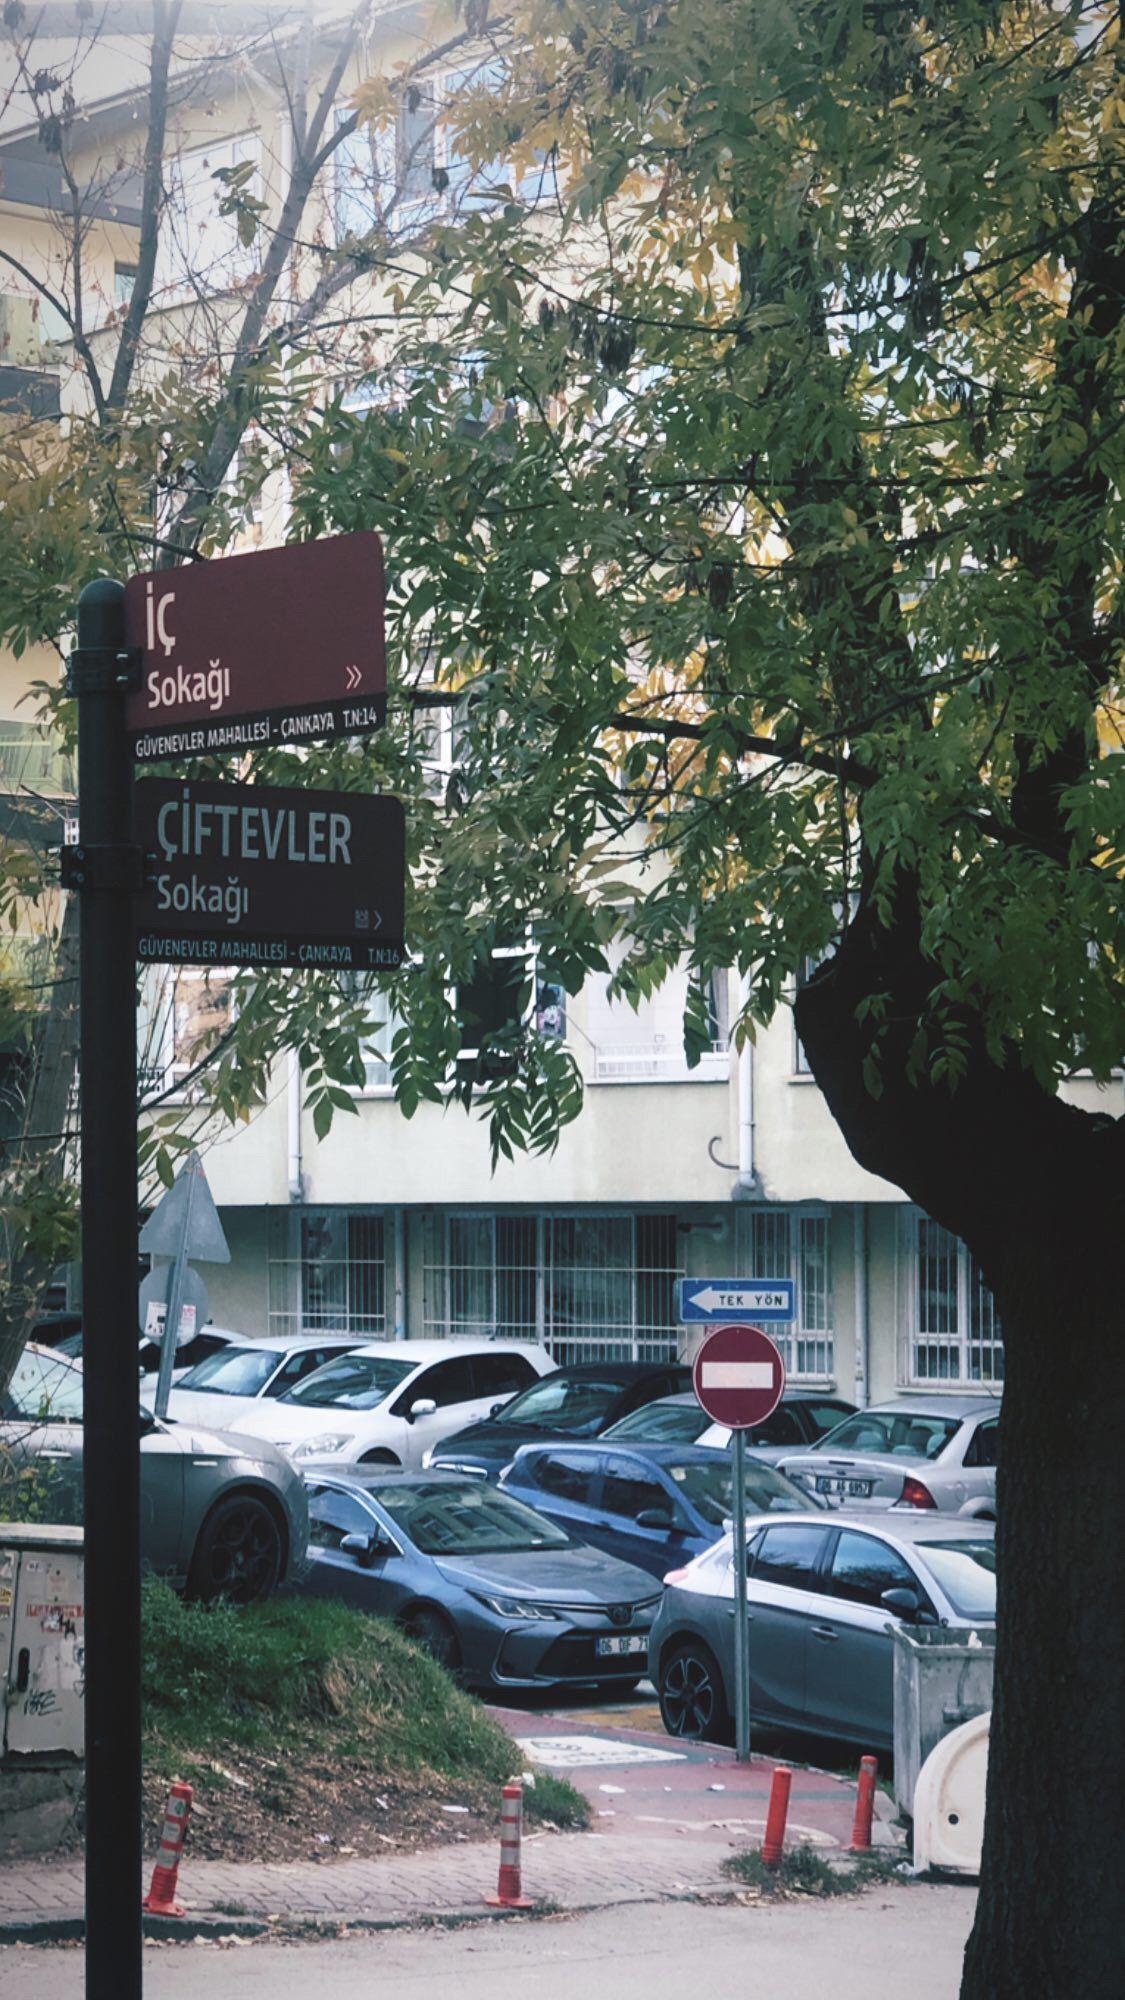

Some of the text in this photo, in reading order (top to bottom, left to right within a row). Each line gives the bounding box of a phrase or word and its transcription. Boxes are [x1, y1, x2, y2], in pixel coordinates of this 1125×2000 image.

[146, 581, 175, 655] İÇ
[148, 658, 230, 710] Sokağı
[136, 731, 205, 757] GÜVENEVLER
[207, 717, 270, 747] MAHALLESİ
[281, 712, 334, 739] ÇANKAYA
[157, 788, 351, 864] ÇİFTEVLER
[157, 874, 248, 924] Sokağı
[139, 934, 217, 957] GÜVENEVLER
[220, 940, 287, 960] MAHALLESİ
[299, 944, 352, 963] ÇANKAYA
[719, 1293, 782, 1306] TEK YÖN
